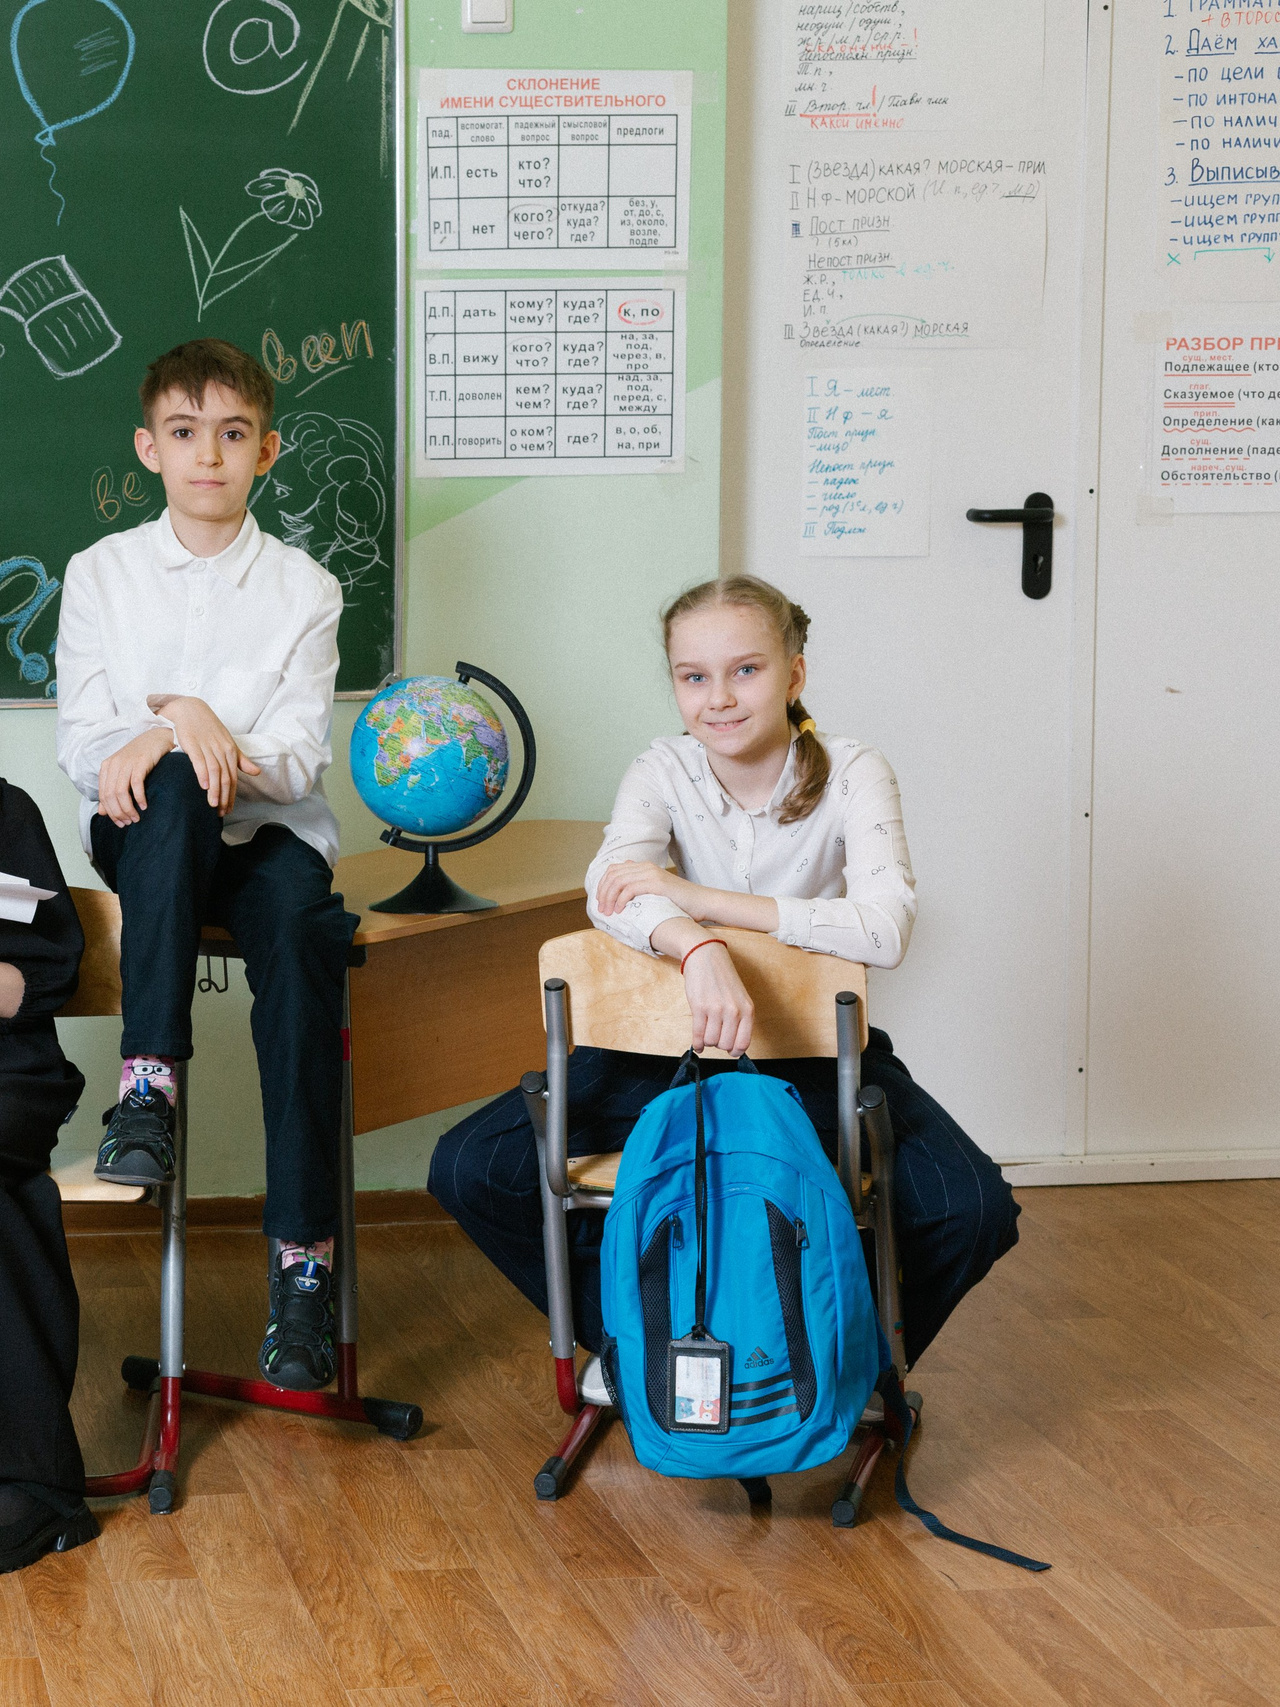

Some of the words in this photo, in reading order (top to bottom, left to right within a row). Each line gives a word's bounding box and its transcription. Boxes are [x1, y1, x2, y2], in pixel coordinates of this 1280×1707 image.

[506, 77, 601, 91] СКЛОНЕНИЕ
[440, 96, 494, 109] ИМЕНИ
[498, 94, 666, 109] СУЩЕСТВИТЕЛЬНОГО
[514, 119, 556, 130] падежный
[562, 120, 608, 129] смысловой
[431, 129, 453, 139] пад.
[470, 134, 496, 143] слово
[520, 134, 550, 143] вопрос
[570, 133, 599, 142] вопрос
[616, 127, 665, 138] предлоги
[518, 157, 551, 170] кто?
[430, 165, 456, 179] И.П.
[466, 168, 498, 178] есть
[518, 175, 551, 188] что?
[560, 200, 606, 213] откуда?
[513, 209, 554, 223] кого?
[566, 216, 599, 229] куда?
[472, 224, 496, 235] нет
[513, 227, 554, 240] чего?
[570, 230, 596, 243] где?
[509, 297, 553, 311] кому?
[563, 297, 604, 310] куда?
[428, 306, 454, 319] Д.П.
[462, 308, 497, 319] дать
[568, 312, 600, 325] где?
[641, 308, 660, 317] по
[509, 313, 554, 326] чему?
[512, 341, 552, 353] кого?
[563, 340, 604, 354] куда?
[1165, 337, 1244, 351] РАЗБОР
[428, 353, 454, 365] В.П.
[463, 354, 499, 365] вижу
[515, 356, 549, 368] что?
[568, 356, 599, 368] где?
[626, 362, 649, 371] про
[1164, 361, 1250, 373] Подлежащее
[515, 383, 550, 394] кем?
[562, 383, 603, 397] куда?
[1163, 388, 1235, 401] Сказуемое
[458, 392, 502, 402] доволен
[515, 398, 551, 409] чем?
[567, 398, 598, 410] где?
[618, 404, 658, 413] между
[1163, 416, 1254, 428] Определение
[509, 428, 518, 437] о
[521, 425, 553, 437] ком?
[429, 435, 454, 446] П.П.
[457, 437, 502, 448] говорить
[567, 432, 599, 445] где?
[509, 443, 518, 452] о
[521, 440, 554, 452] чем?
[638, 441, 660, 451] при
[1161, 445, 1244, 456] Дополнение
[1160, 470, 1271, 481] Обстоятельство
[744, 1357, 775, 1370] adidas
